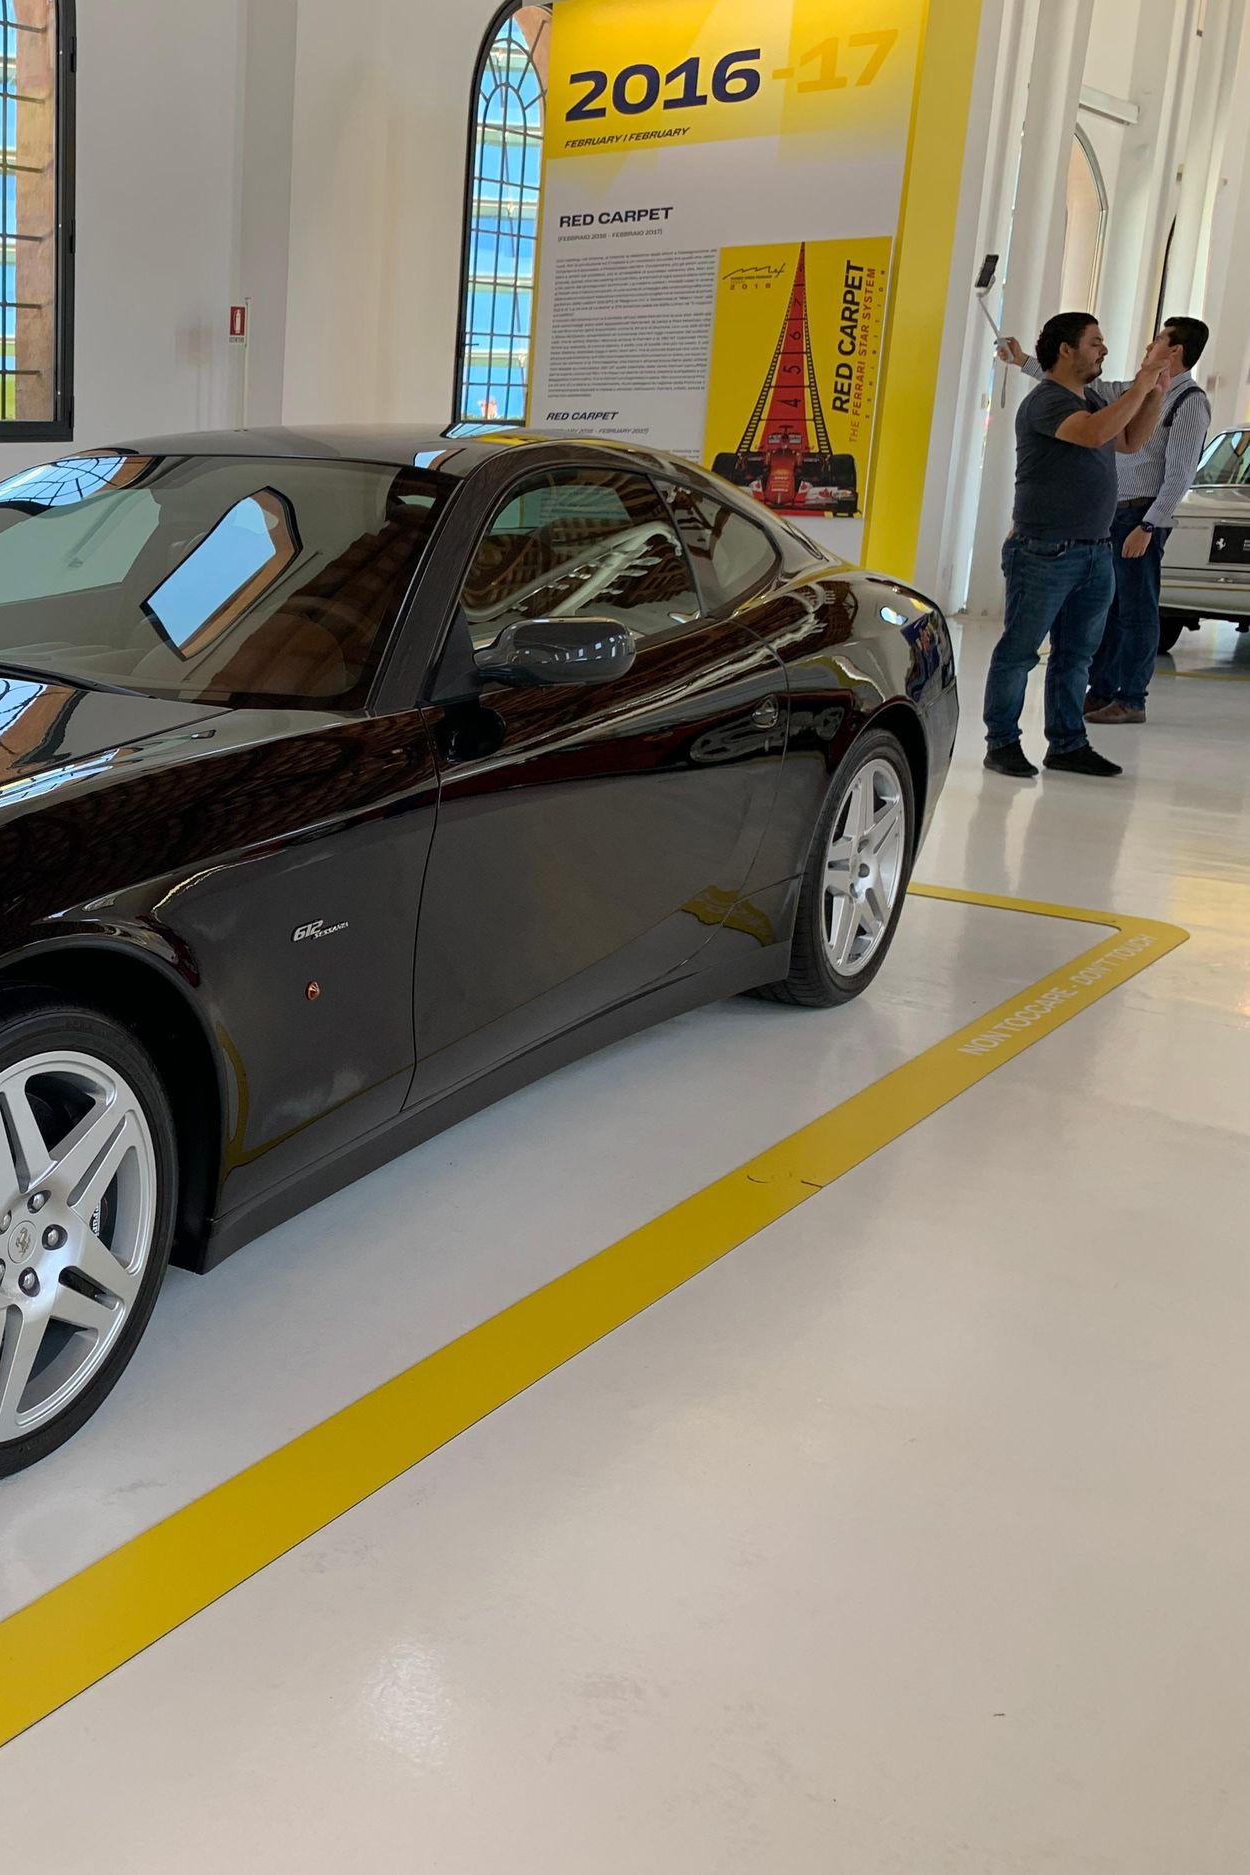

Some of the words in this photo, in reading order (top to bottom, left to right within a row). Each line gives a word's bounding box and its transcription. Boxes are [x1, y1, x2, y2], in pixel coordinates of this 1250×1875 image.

[565, 48, 762, 122] 2016
[564, 133, 622, 150] FEBRUARY
[628, 126, 691, 143] FEBRUARY
[559, 214, 595, 228] RED
[598, 206, 674, 225] CARPET
[862, 268, 876, 320] SYSTEM
[837, 260, 864, 357] CARPET
[789, 330, 801, 341] 6
[858, 324, 870, 357] STAR
[783, 364, 801, 375] 5
[832, 362, 854, 414] RED
[852, 361, 866, 417] FERRARI
[779, 398, 799, 408] 4
[546, 412, 569, 421] RED
[571, 411, 619, 421] CARPET
[849, 420, 860, 443] THE
[293, 919, 324, 942] 612
[958, 1025, 1007, 1056] NON
[999, 988, 1078, 1035] TOCCARE
[1108, 933, 1159, 966] TOUCH
